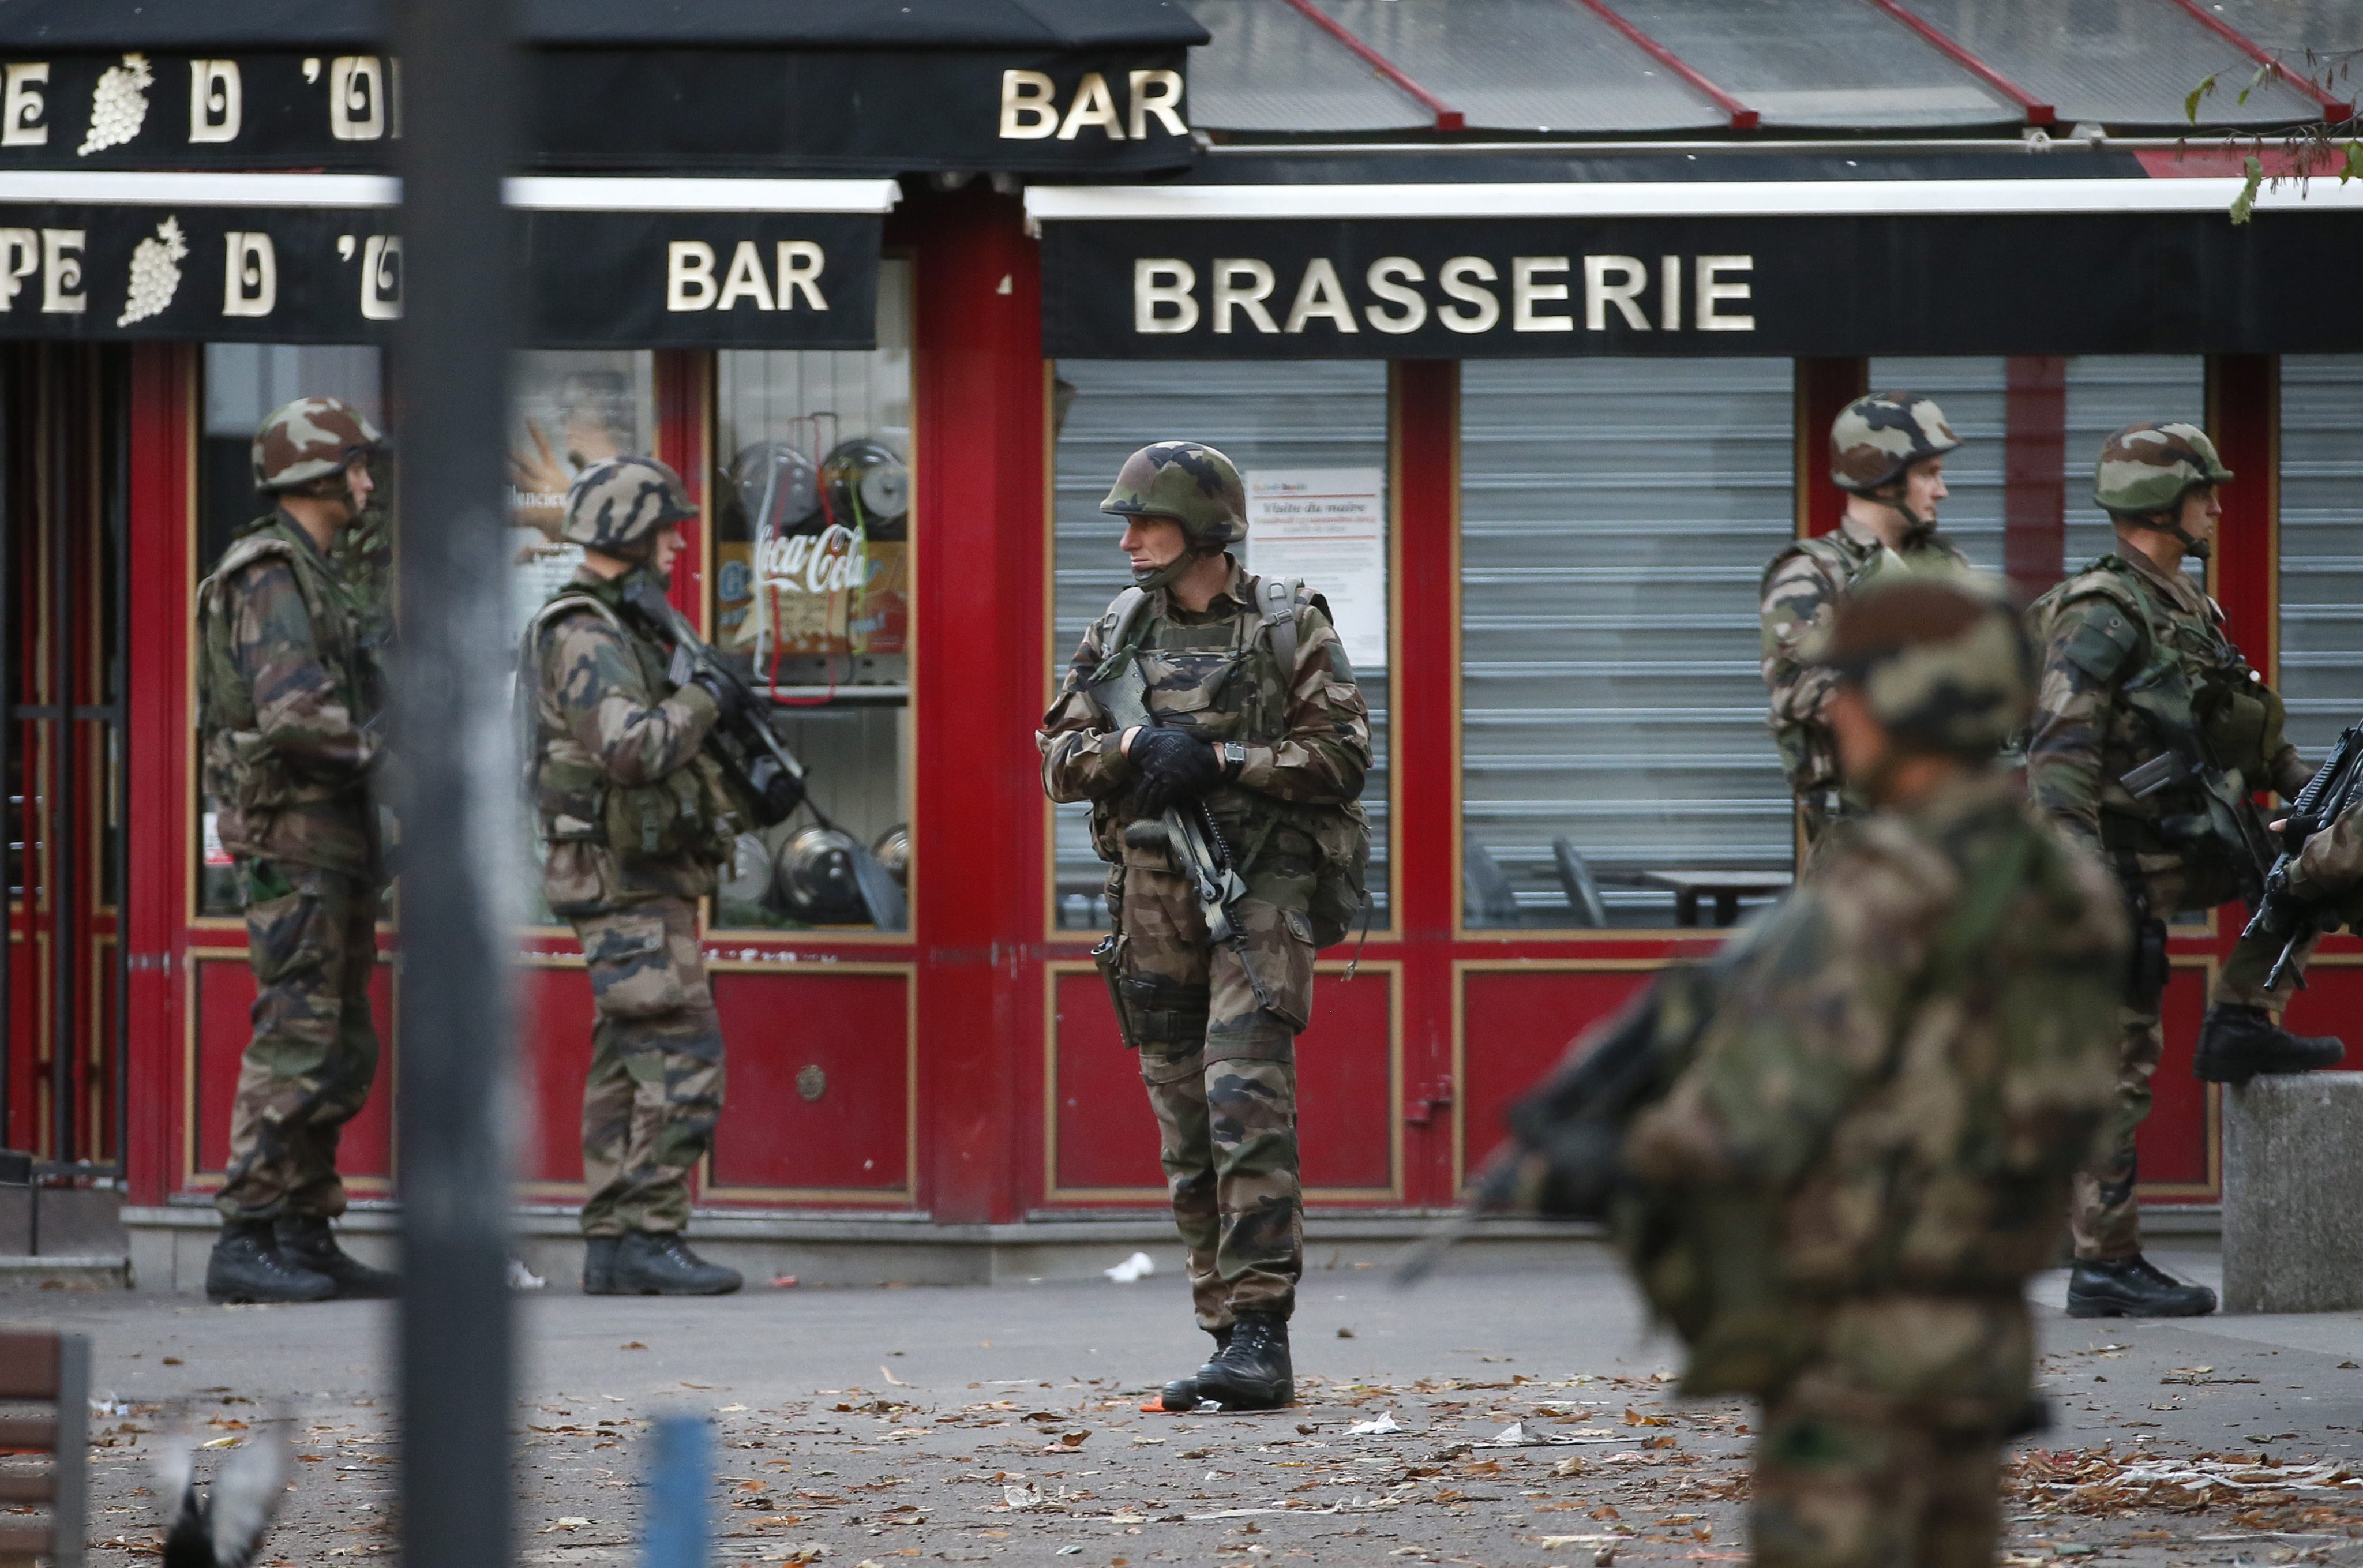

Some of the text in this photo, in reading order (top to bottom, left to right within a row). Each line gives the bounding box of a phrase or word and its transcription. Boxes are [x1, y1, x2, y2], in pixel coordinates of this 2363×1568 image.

[0, 62, 50, 146] E
[999, 69, 1189, 141] BAR
[666, 239, 829, 312] BAR
[1134, 254, 1756, 335] BRASSERIE
